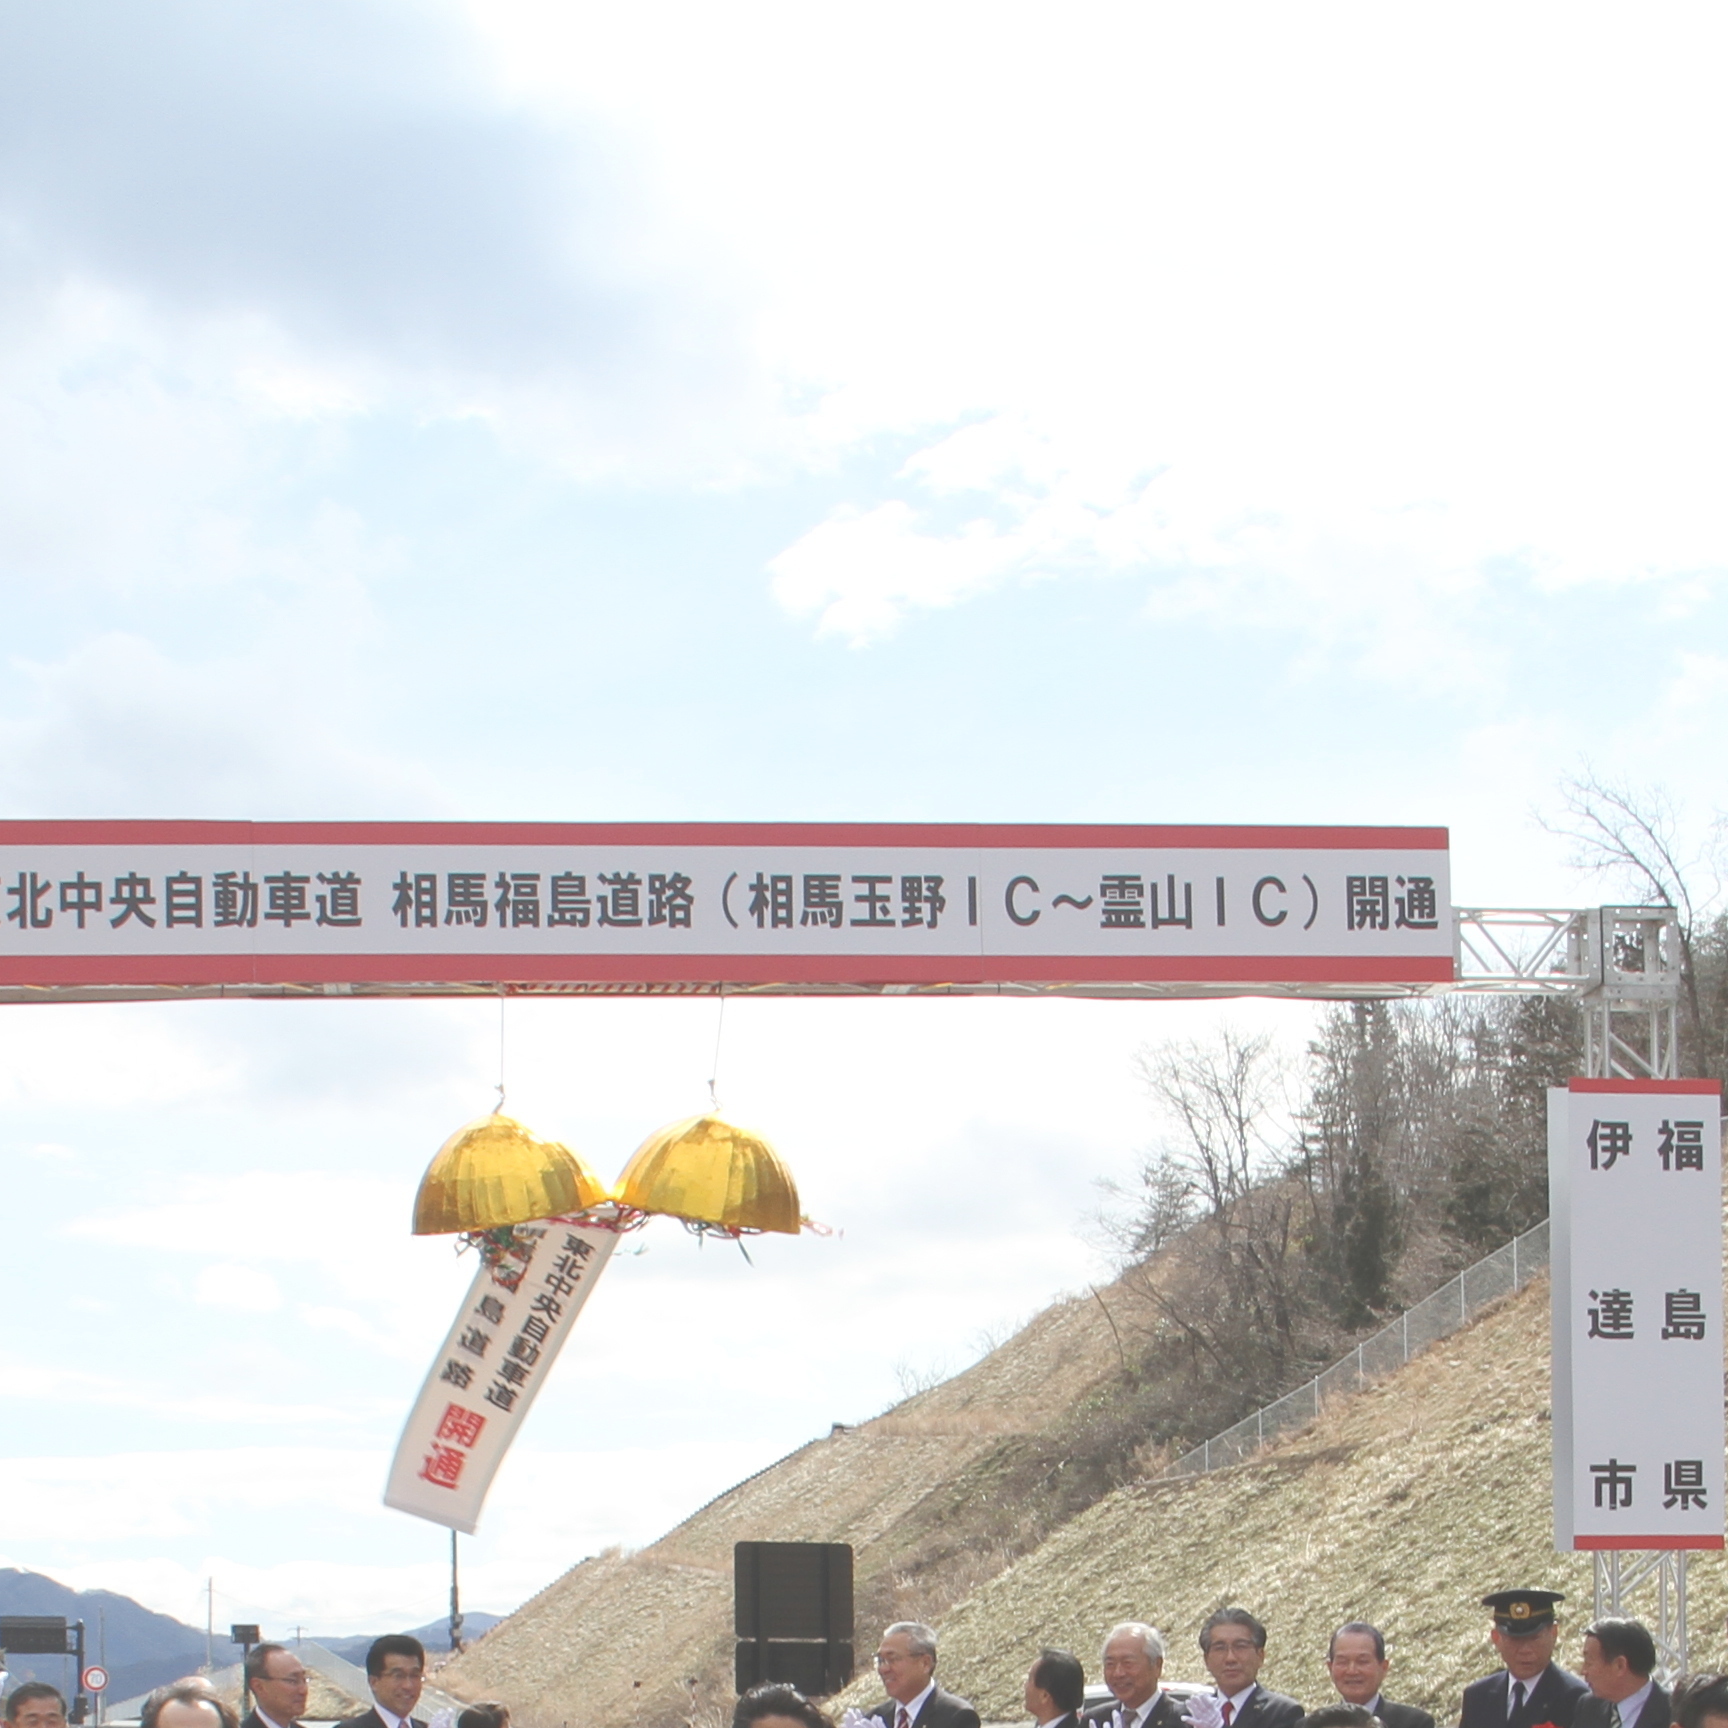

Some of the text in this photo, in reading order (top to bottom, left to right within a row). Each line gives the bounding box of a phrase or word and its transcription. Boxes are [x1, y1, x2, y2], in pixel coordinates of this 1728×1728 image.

[483, 1231, 597, 1413] 東北中央自動車道
[1586, 1118, 1637, 1511] 伊達市
[1657, 1119, 1708, 1511] 福島県
[417, 1401, 488, 1491] 開通
[90, 1673, 103, 1685] 70
